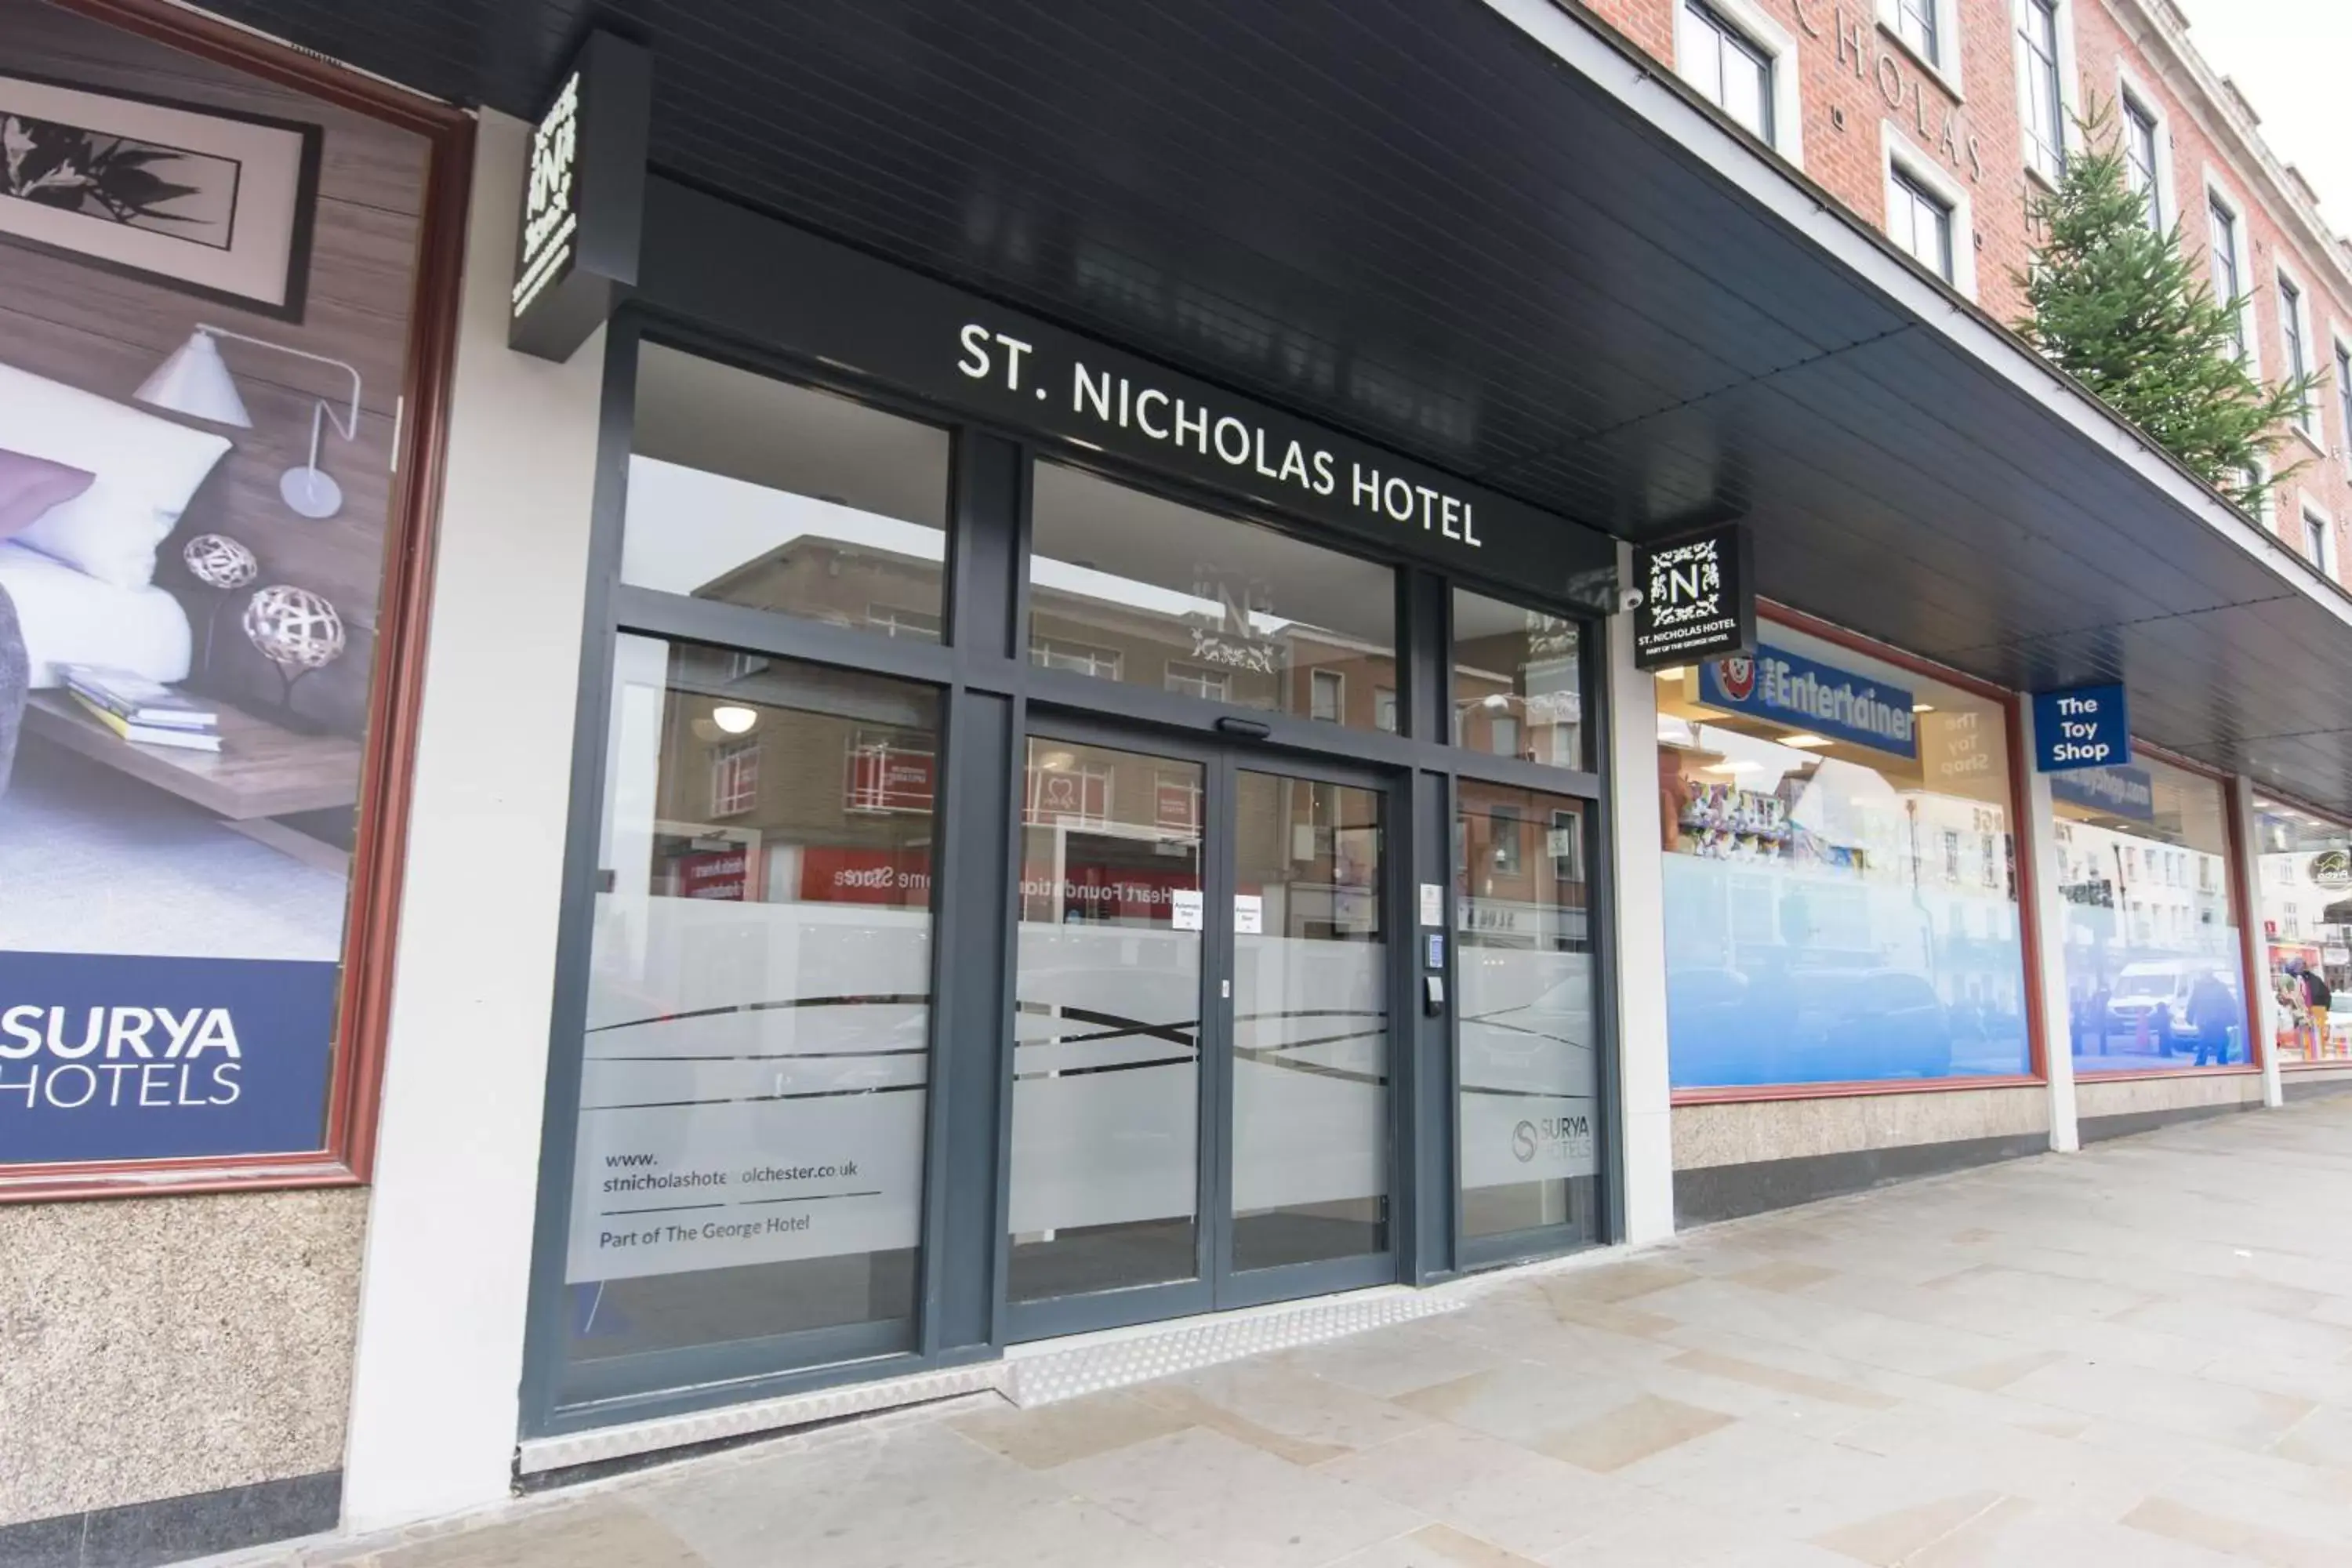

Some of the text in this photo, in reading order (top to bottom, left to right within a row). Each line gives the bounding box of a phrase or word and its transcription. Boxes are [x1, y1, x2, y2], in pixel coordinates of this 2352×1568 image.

[957, 323, 1482, 548] ST. NICHOLAS HOTEL
[1669, 564, 1699, 604] N
[1638, 618, 1736, 645] ST. NICHOLAS HOTEL
[1776, 660, 1915, 742] Entertainer
[2057, 697, 2098, 716] The
[2060, 721, 2098, 741] Toy
[2053, 742, 2110, 761] Shop
[0, 1005, 241, 1059] SURYA
[0, 1063, 241, 1109] HOTELS
[1541, 1116, 1589, 1140] SURYA
[605, 1153, 659, 1167] www.
[600, 1214, 810, 1249] Part of The George Hotel
